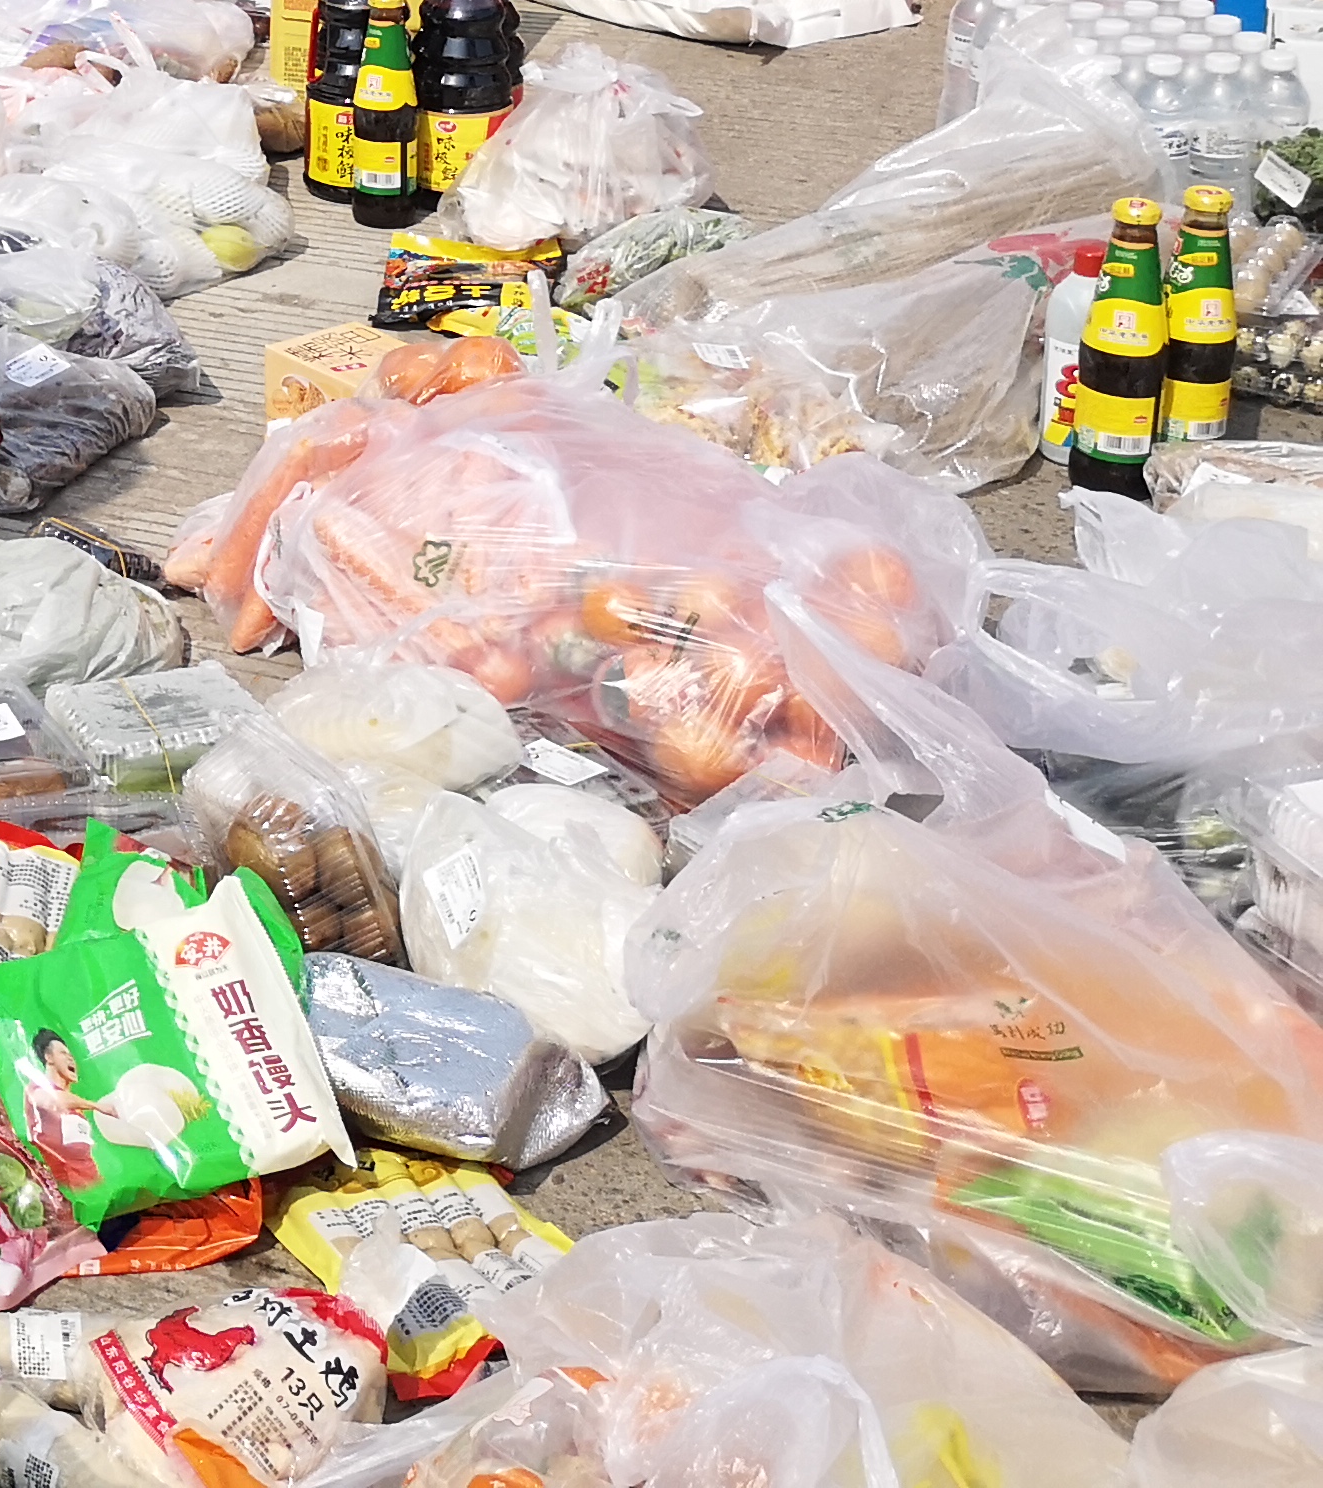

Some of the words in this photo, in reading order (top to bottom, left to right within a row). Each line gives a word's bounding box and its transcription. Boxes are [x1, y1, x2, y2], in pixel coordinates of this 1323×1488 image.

[180, 935, 224, 965] 安井
[82, 1009, 147, 1055] 更安心
[209, 978, 318, 1134] 奶香馒头
[280, 1366, 325, 1421] 13只
